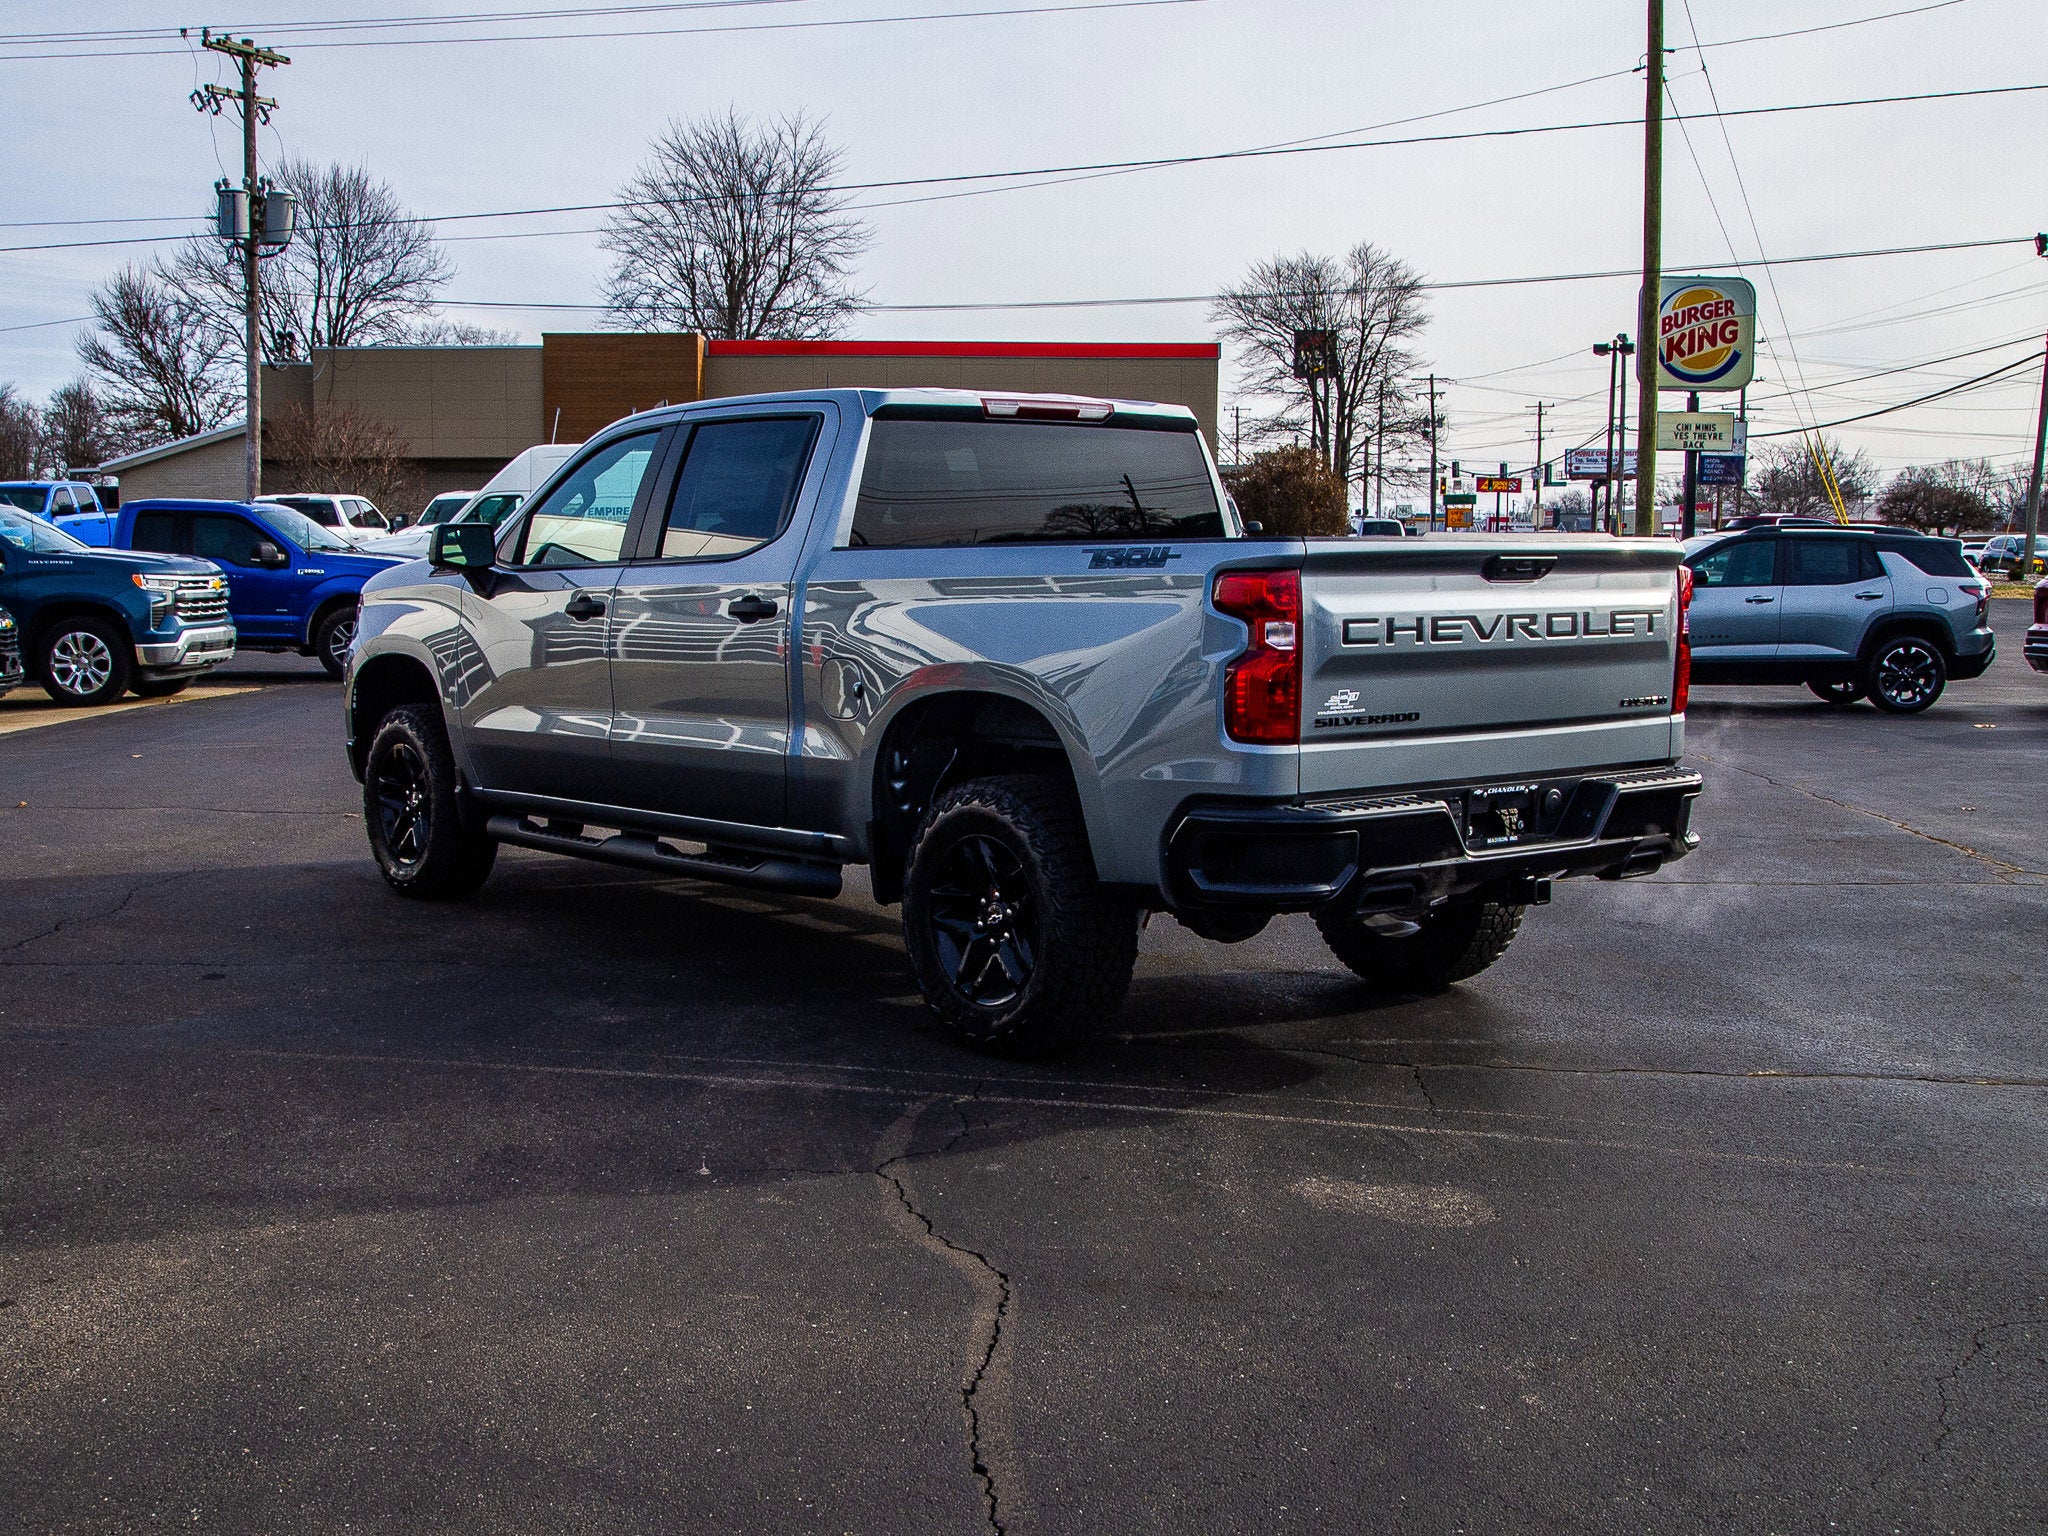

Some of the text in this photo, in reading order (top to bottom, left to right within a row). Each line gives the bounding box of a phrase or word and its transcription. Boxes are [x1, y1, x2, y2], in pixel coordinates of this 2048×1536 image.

[1661, 299, 1736, 336] BURGER
[1665, 319, 1739, 363] KING
[1676, 423, 1717, 432] CINI MINIS
[1674, 432, 1723, 441] YES THEYRE
[1683, 441, 1705, 449] BACK
[587, 506, 631, 517] EMPIRE
[1341, 609, 1664, 647] CHEVROLET
[1314, 712, 1420, 728] SILVERADO
[1487, 785, 1526, 794] CHANDLER
